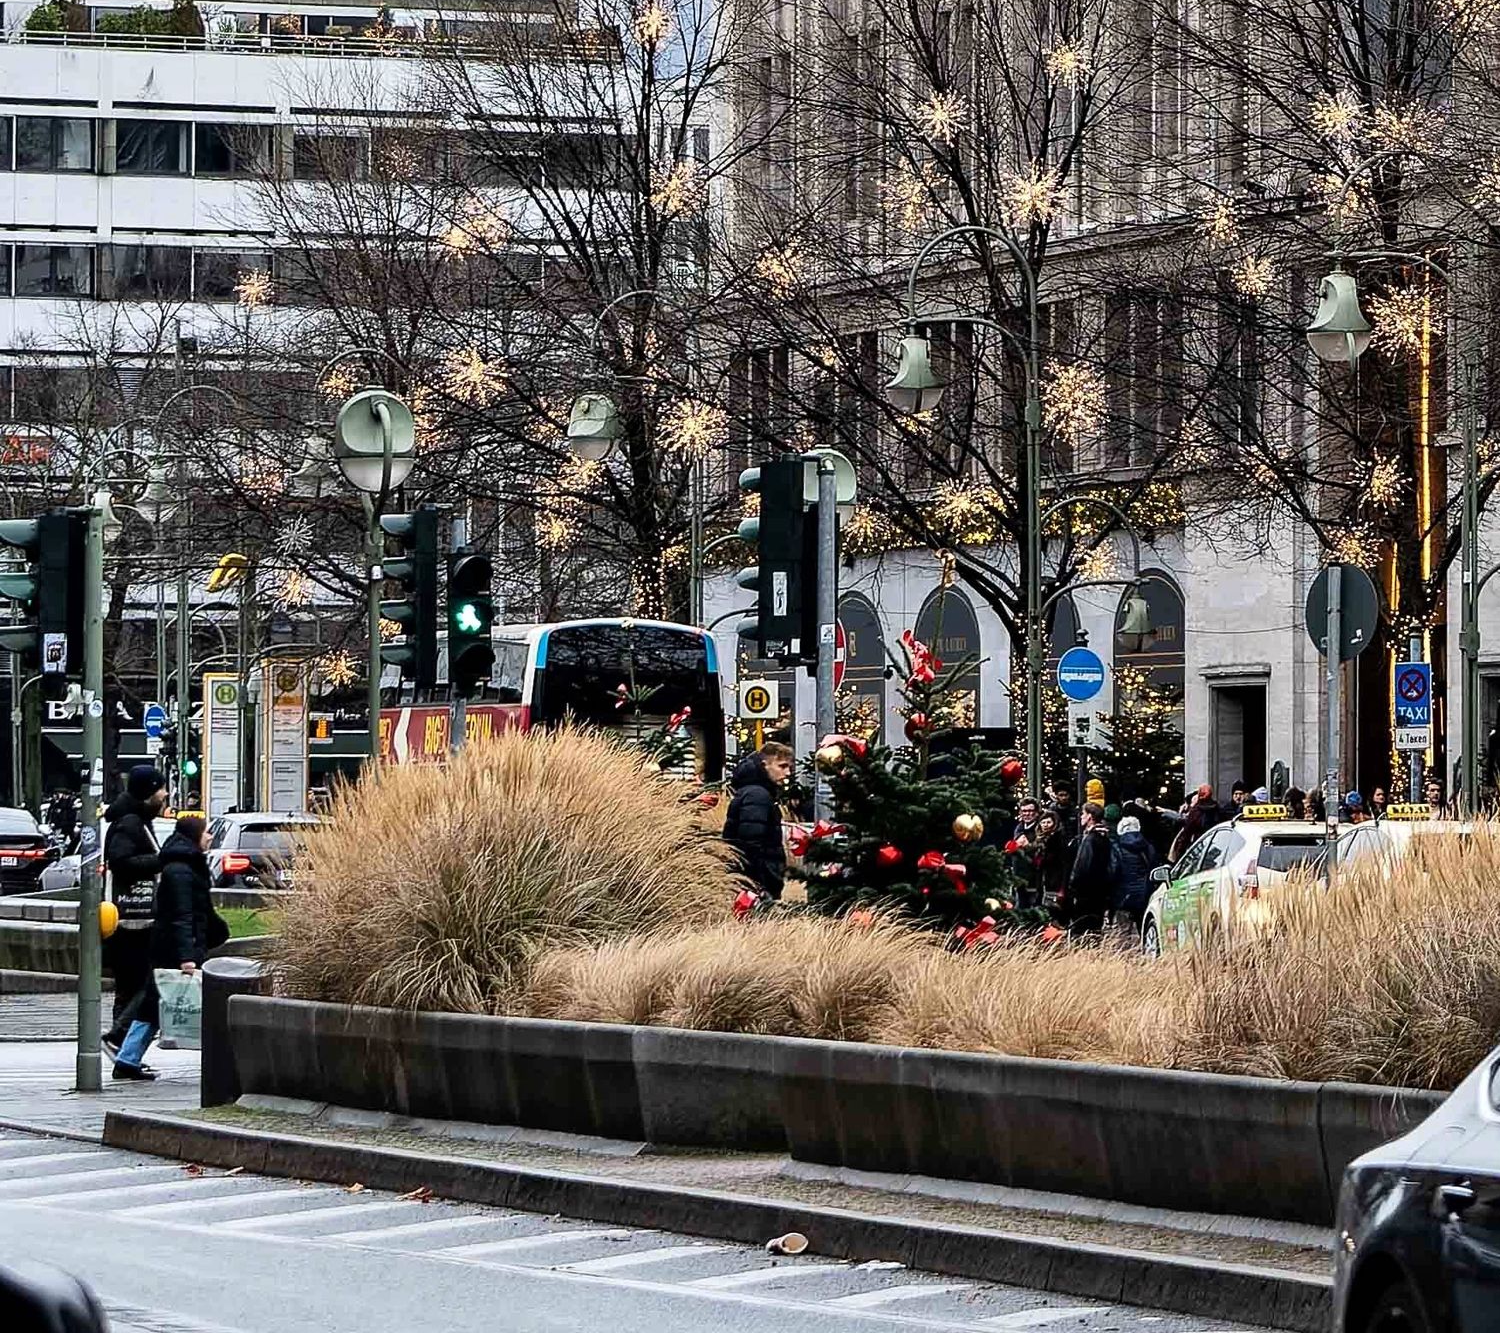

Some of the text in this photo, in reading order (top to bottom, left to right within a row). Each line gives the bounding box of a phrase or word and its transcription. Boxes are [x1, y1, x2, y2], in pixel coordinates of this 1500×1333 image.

[1398, 707, 1428, 721] TAXI
[1406, 734, 1427, 743] Taxen
[1252, 805, 1285, 816] TAXI
